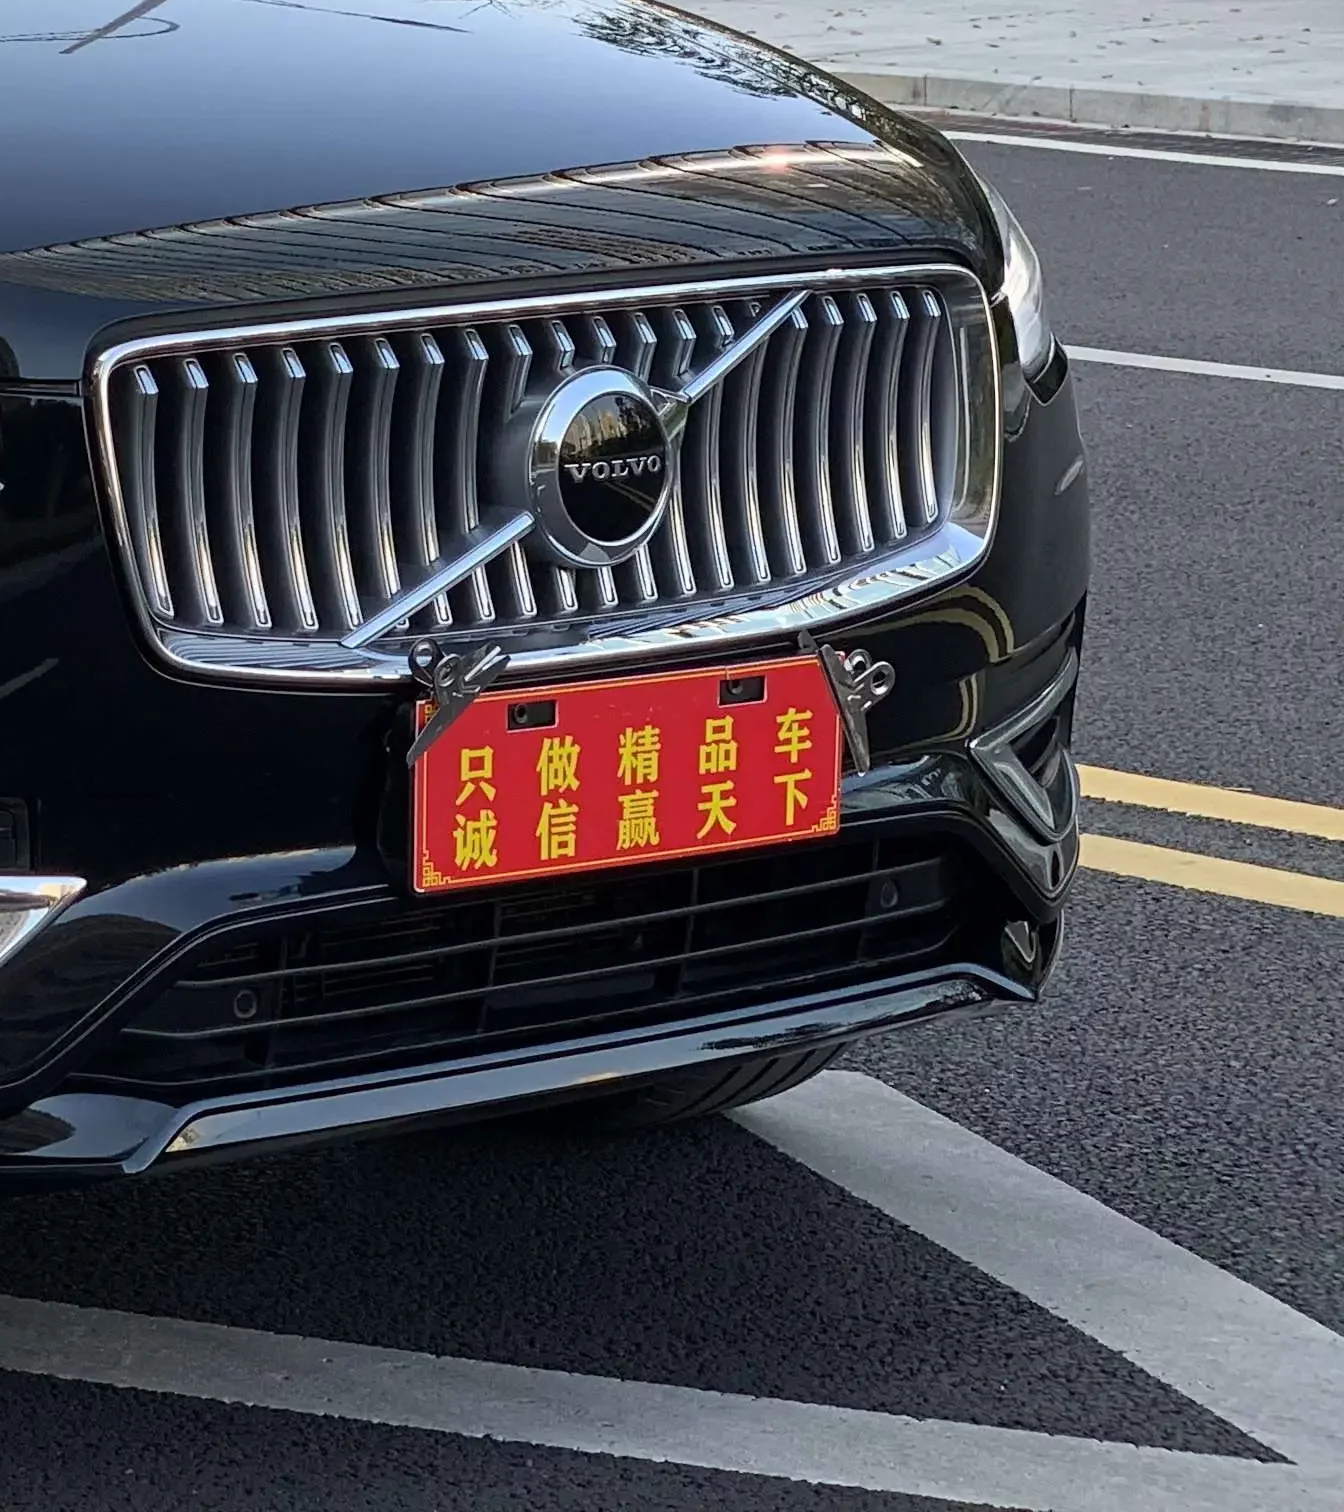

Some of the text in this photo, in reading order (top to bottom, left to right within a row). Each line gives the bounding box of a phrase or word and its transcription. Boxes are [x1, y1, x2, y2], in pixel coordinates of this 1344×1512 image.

[564, 455, 662, 484] VOLVO
[454, 707, 813, 806] 只做精品车
[452, 768, 812, 871] 诚信赢天下
